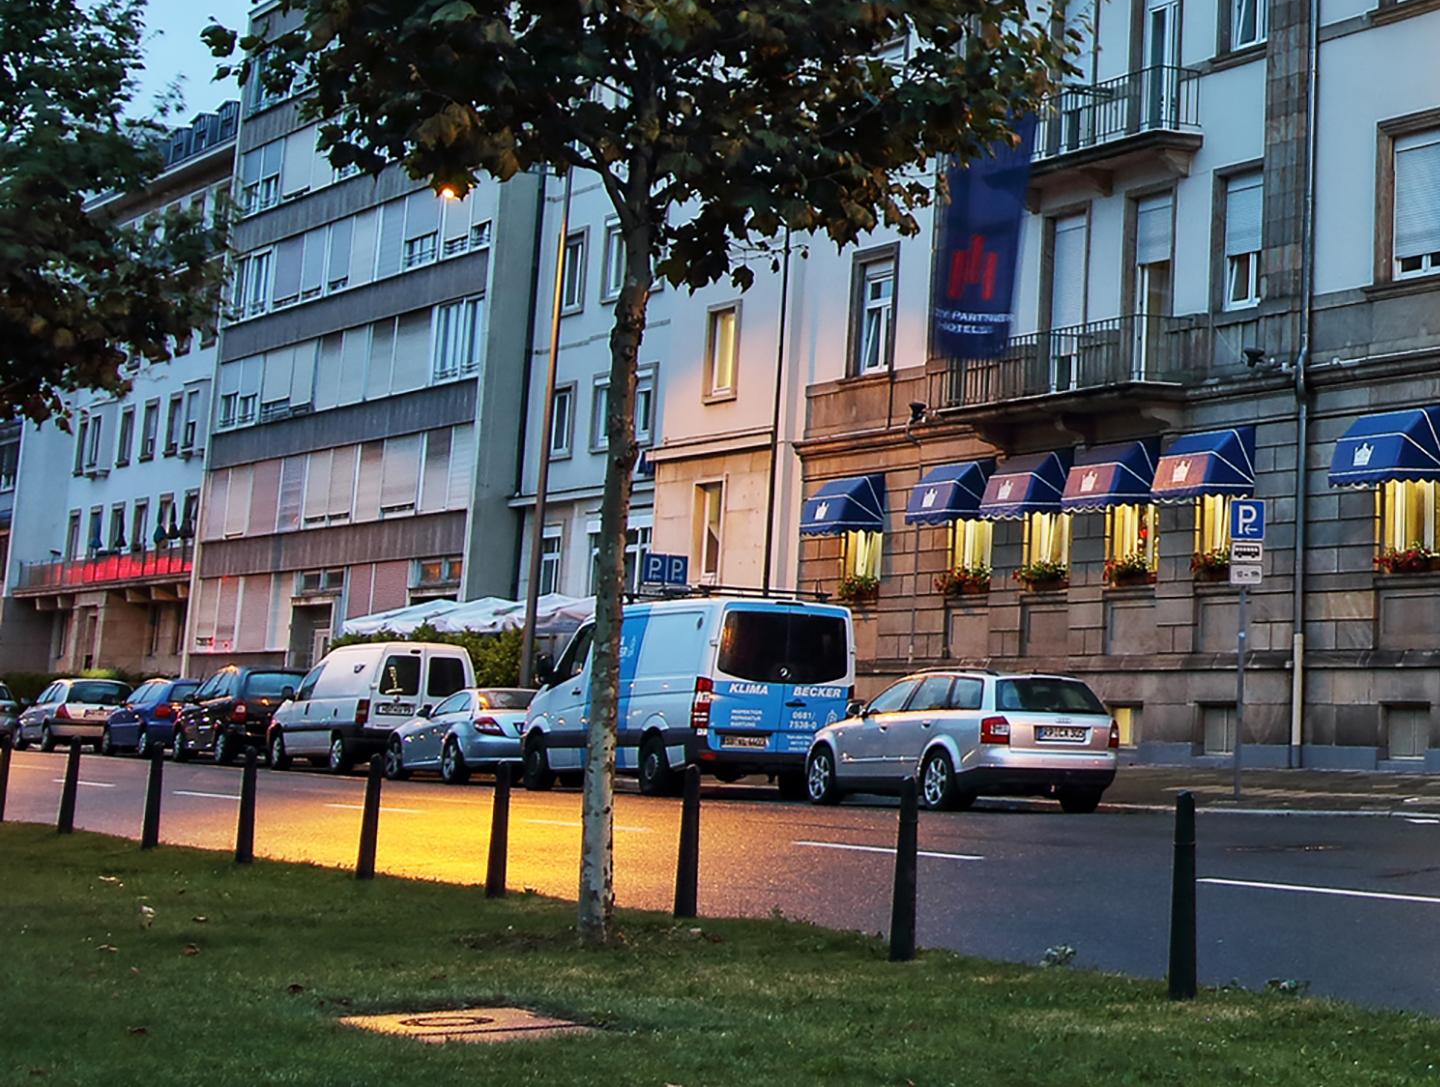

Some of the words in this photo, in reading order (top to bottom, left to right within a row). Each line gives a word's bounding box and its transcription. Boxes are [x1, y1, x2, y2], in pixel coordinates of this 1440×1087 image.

[1238, 504, 1257, 534] P
[649, 557, 662, 579] P
[671, 559, 684, 581] P
[729, 683, 769, 695] KLIMA
[793, 686, 842, 698] BECKER
